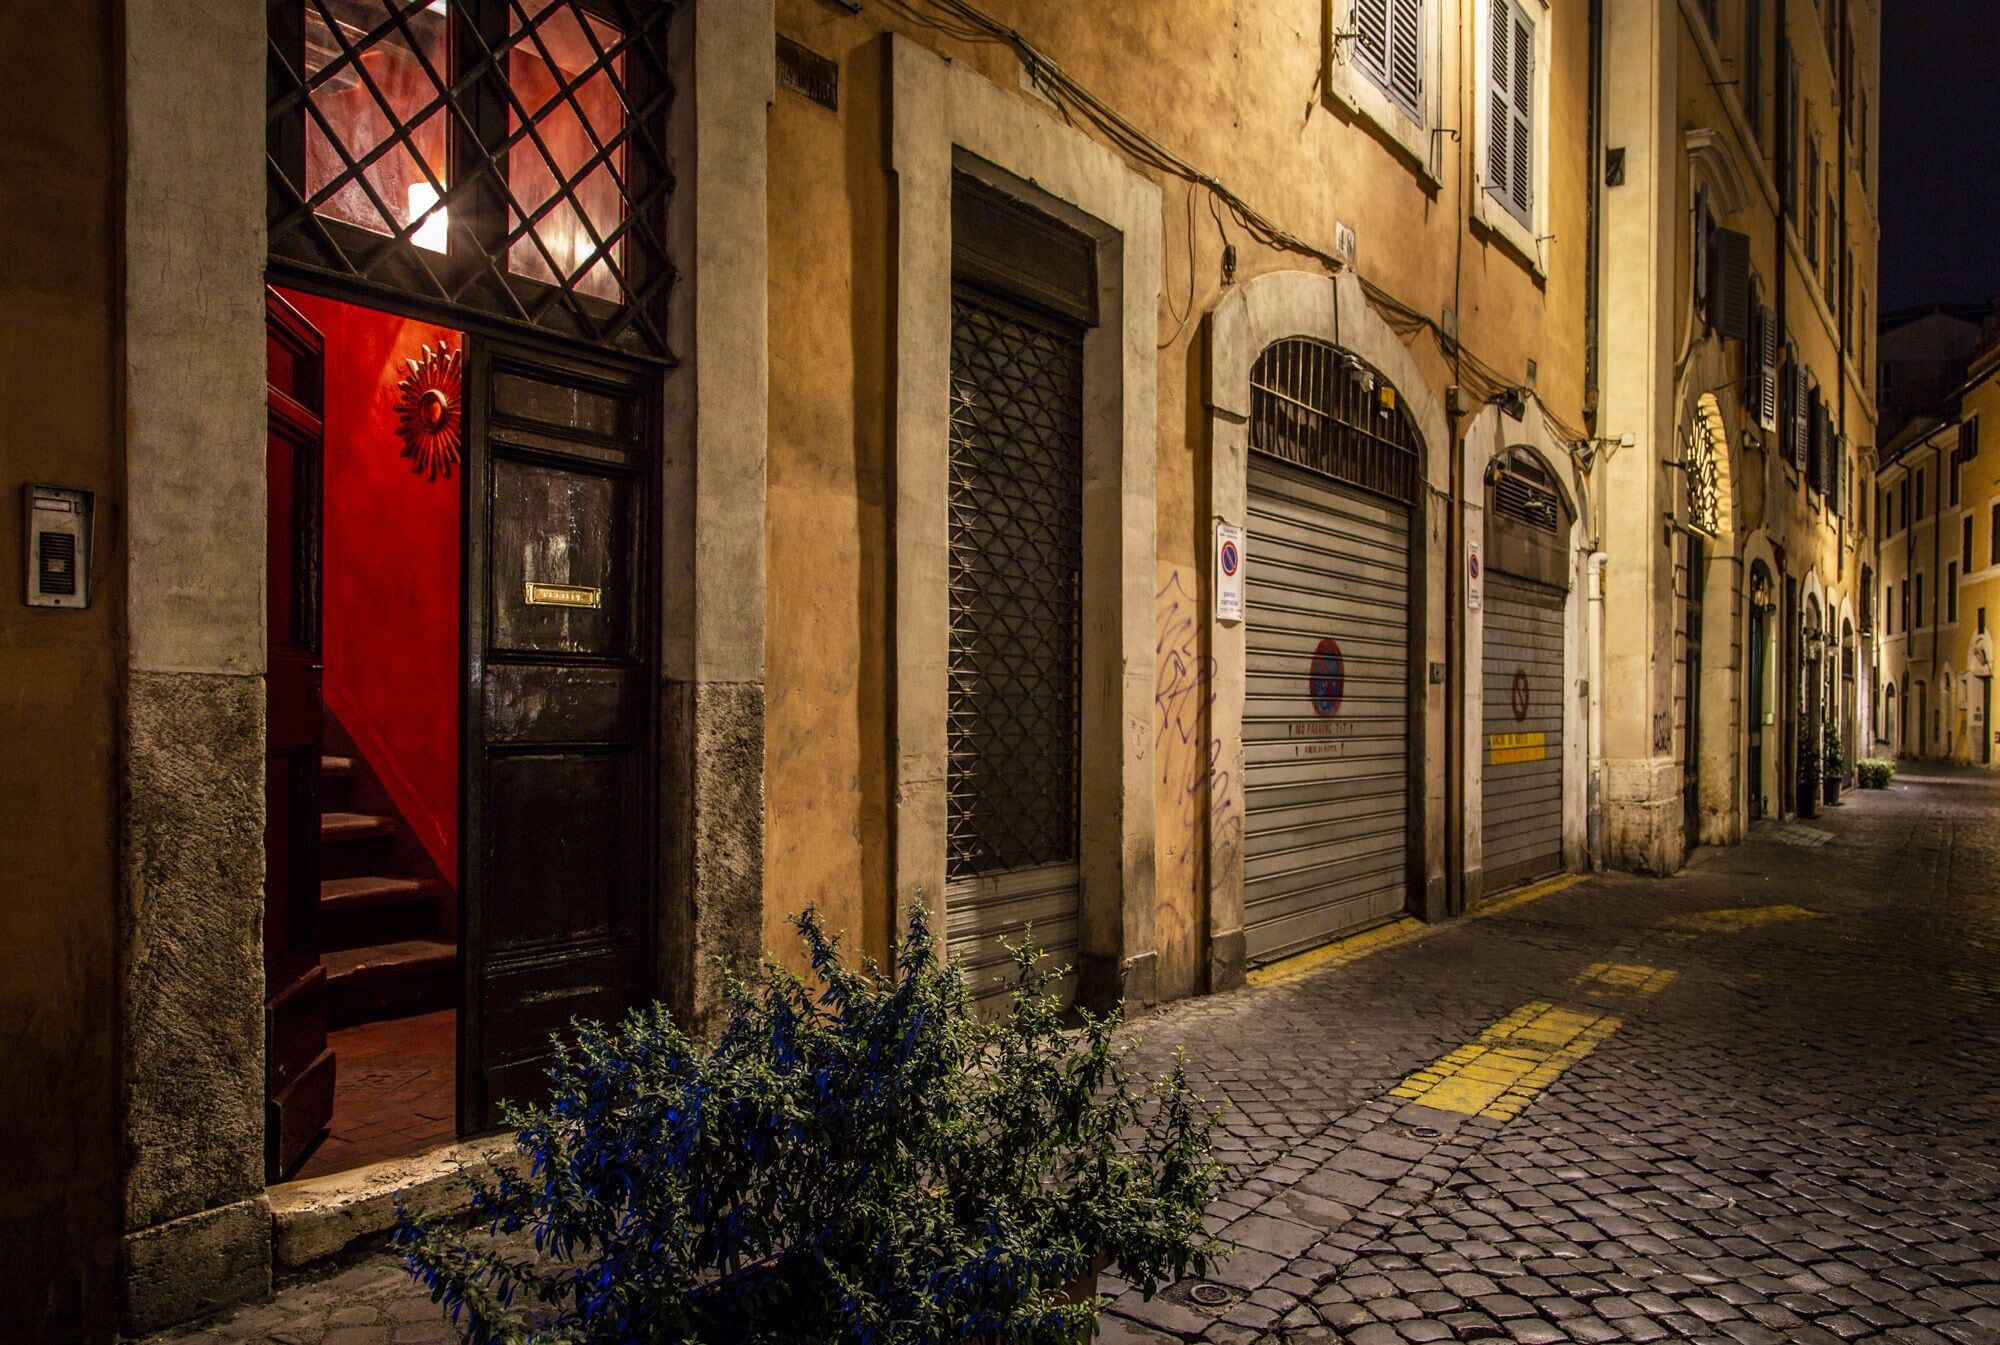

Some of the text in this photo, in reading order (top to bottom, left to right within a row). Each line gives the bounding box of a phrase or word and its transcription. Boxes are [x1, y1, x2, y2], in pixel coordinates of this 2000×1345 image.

[1338, 229, 1353, 255] 48
[1296, 723, 1305, 735] NO
[1307, 723, 1332, 734] PARKING
